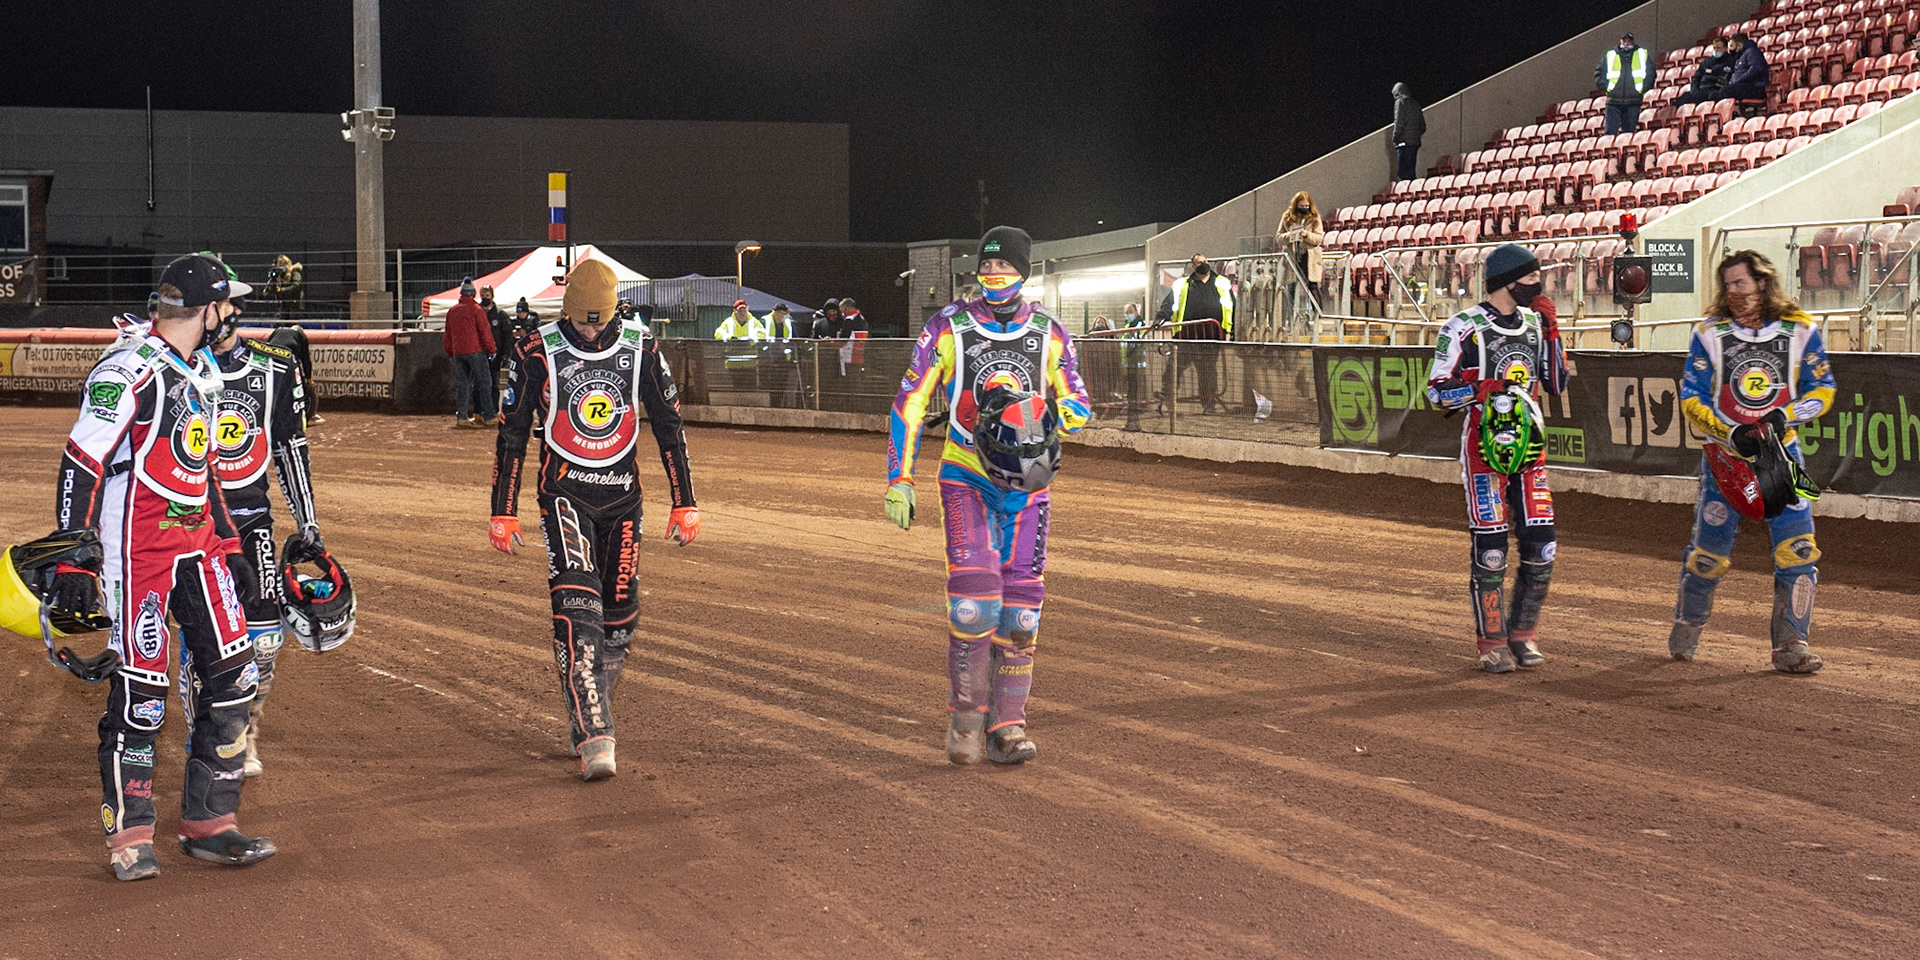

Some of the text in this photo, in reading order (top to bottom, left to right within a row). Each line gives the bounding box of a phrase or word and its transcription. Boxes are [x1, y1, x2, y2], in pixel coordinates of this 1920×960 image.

[1649, 243, 1683, 252] BLOCK A
[1, 264, 24, 280] OF
[1677, 264, 1684, 272] B
[1026, 338, 1039, 351] 9
[23, 346, 41, 361] Tel:
[43, 347, 73, 362] 01706
[313, 348, 385, 364] 01706 640055
[619, 356, 630, 369] 6
[969, 349, 1035, 373] PETER CRAVEN
[251, 377, 263, 389] 4
[563, 369, 627, 393] PETER CRAVEN
[977, 364, 996, 385] BELLE
[1015, 369, 1028, 386] ACES
[325, 382, 364, 397] VEHICLE
[366, 383, 390, 398] HIRE
[571, 385, 589, 406] BELLE
[607, 386, 621, 402] ACES
[224, 389, 261, 412] CRAVEN
[240, 406, 254, 425] ACES
[572, 433, 622, 450] MEMORIAL
[567, 467, 633, 491] wearelusty
[1474, 474, 1494, 522] ALBON
[254, 528, 276, 600] poultec
[615, 520, 634, 602] MCNICOLL
